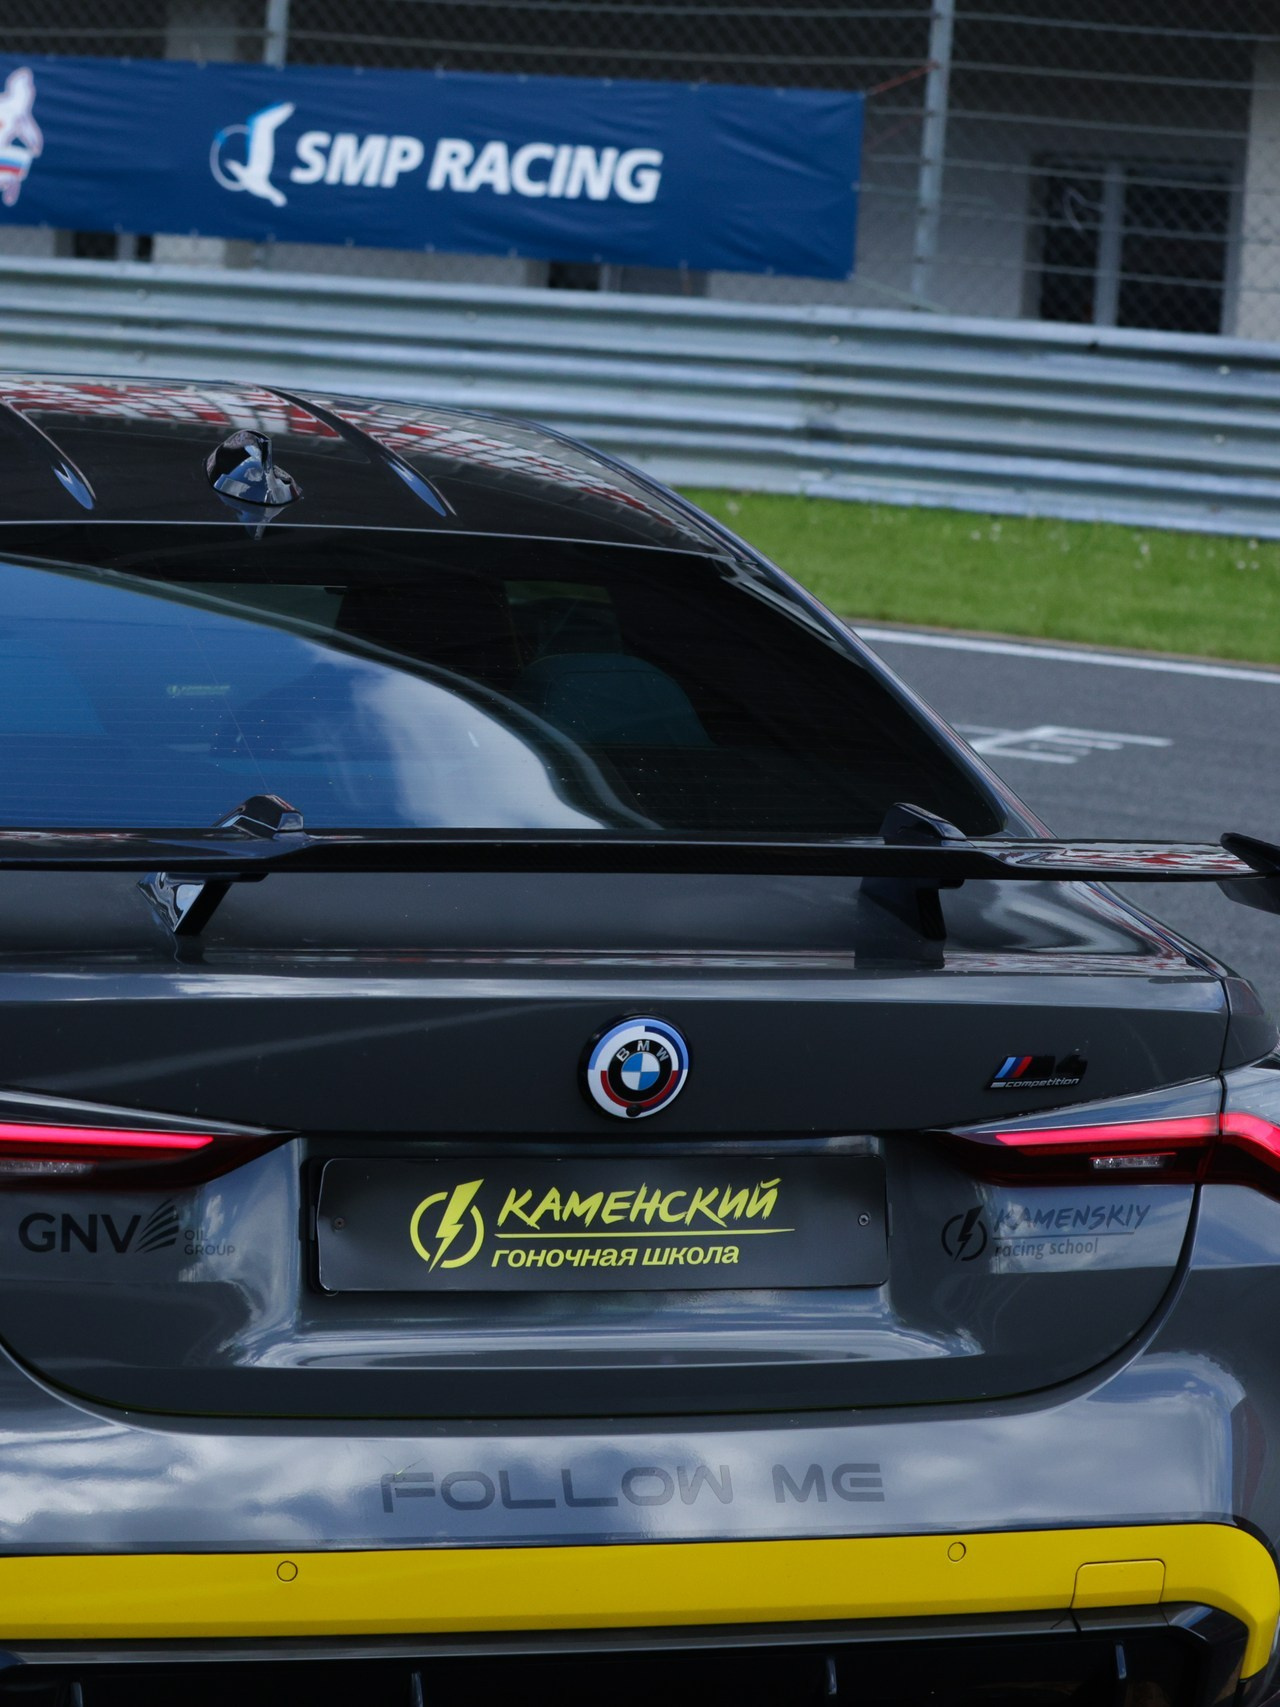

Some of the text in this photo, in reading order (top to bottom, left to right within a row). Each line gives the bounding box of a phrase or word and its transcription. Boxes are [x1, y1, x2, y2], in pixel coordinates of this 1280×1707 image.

[290, 131, 663, 203] SMP RACING
[616, 1040, 669, 1062] BMW
[1005, 1078, 1079, 1088] competition
[497, 1177, 782, 1230] КАМЕНСКИЙ
[992, 1204, 1152, 1233] KAMENSKIY
[18, 1212, 142, 1254] GNV
[184, 1229, 209, 1242] OIL
[184, 1244, 236, 1257] GROUP
[641, 1245, 740, 1266] школа
[994, 1237, 1099, 1260] racing school
[381, 1462, 885, 1514] FOLLOW ME
